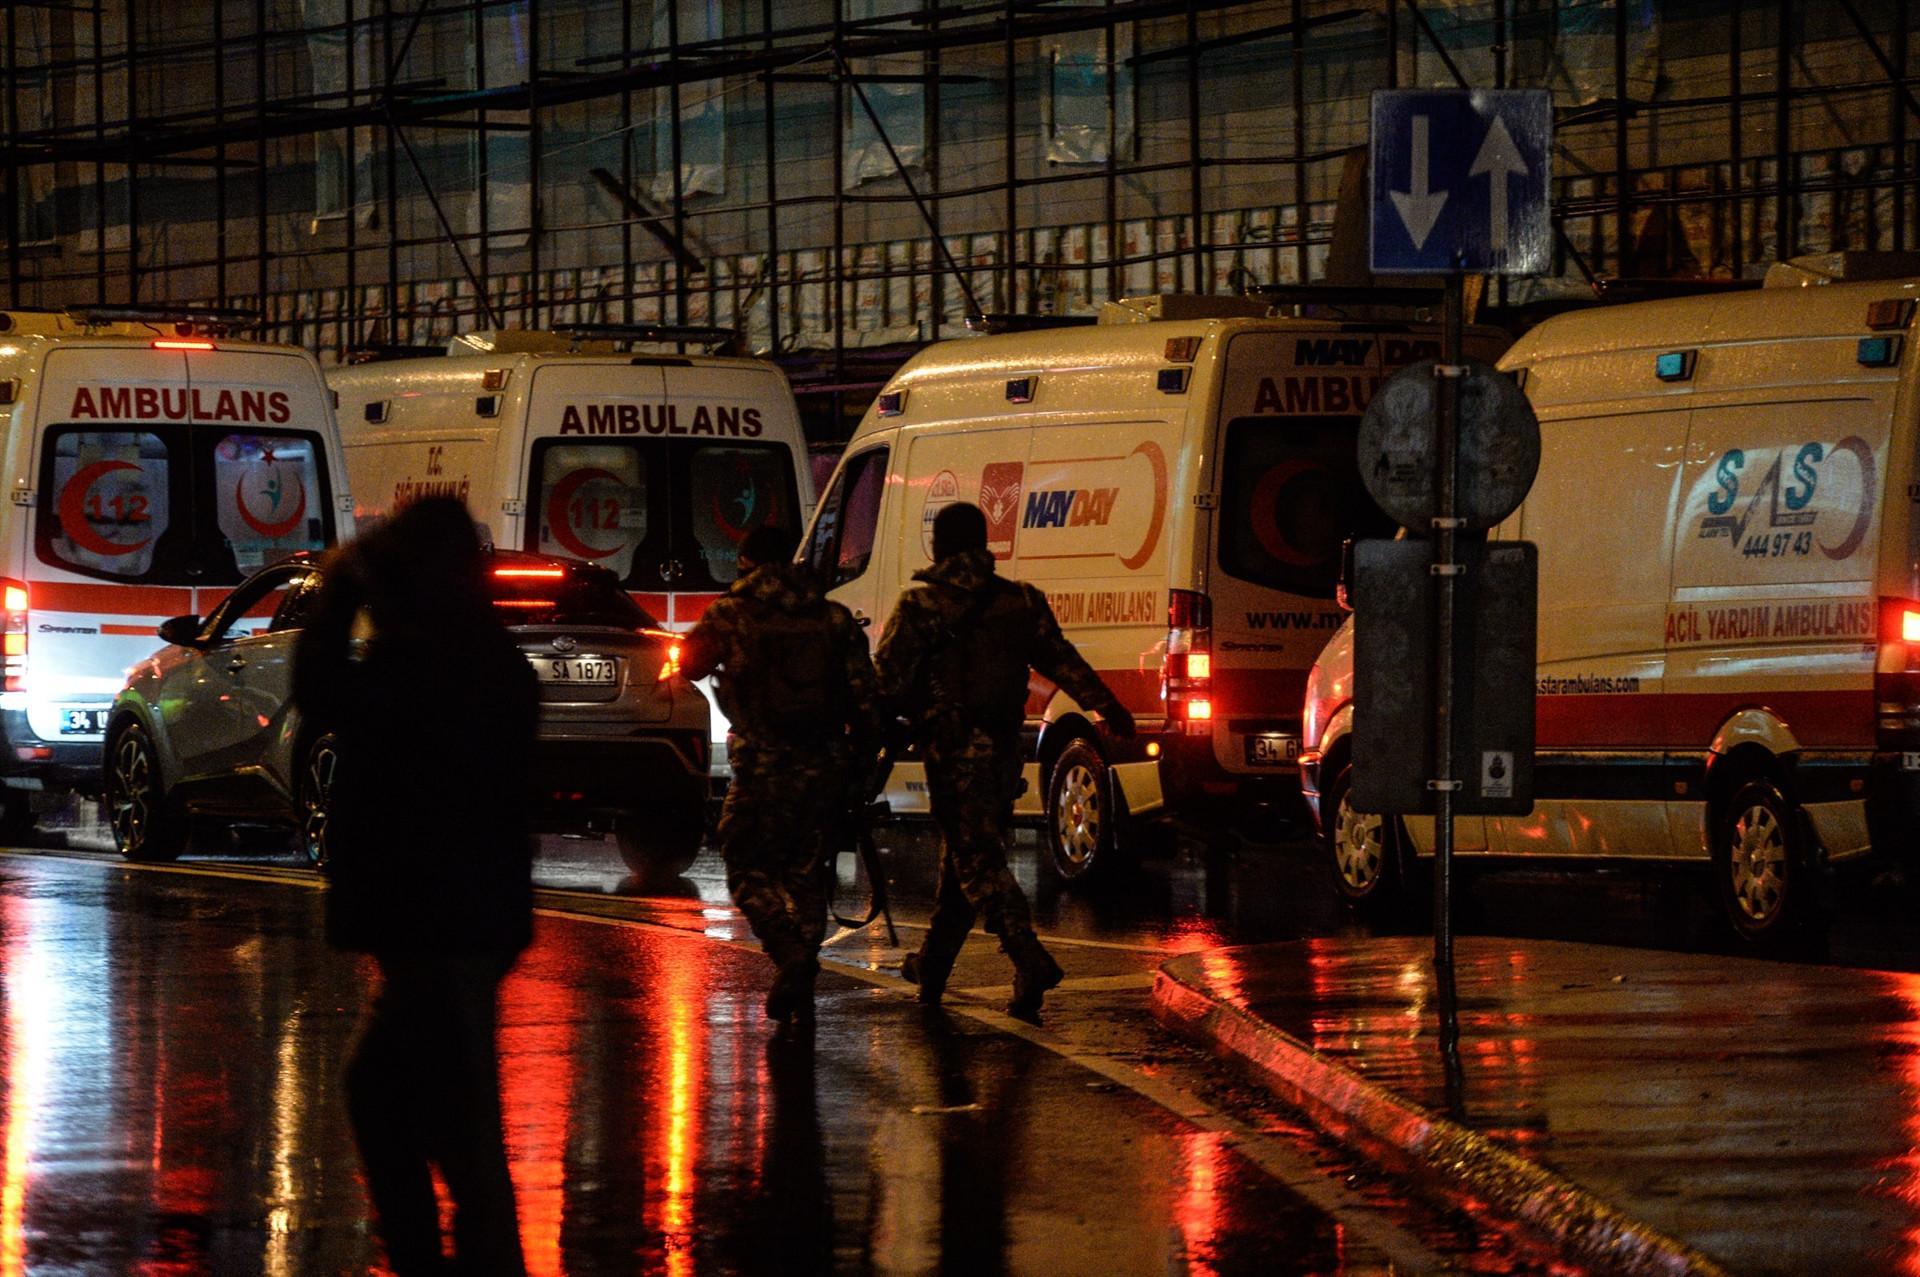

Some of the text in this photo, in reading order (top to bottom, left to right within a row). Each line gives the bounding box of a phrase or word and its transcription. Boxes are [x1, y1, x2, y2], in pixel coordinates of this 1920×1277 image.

[1294, 339, 1375, 366] MAY
[70, 387, 291, 424] AMBULANS
[1253, 376, 1387, 414] AMBU
[559, 404, 763, 438] AMBULANS
[86, 495, 152, 522] 112
[569, 498, 619, 530] 112
[1742, 531, 1813, 559] 444 97 43
[1087, 591, 1157, 623] AMBULANSI
[1666, 601, 1878, 644] ACİL YARDIM AMBULANSI
[552, 661, 613, 680] SA 1873
[69, 711, 92, 730] 34
[1256, 741, 1278, 760] 34
